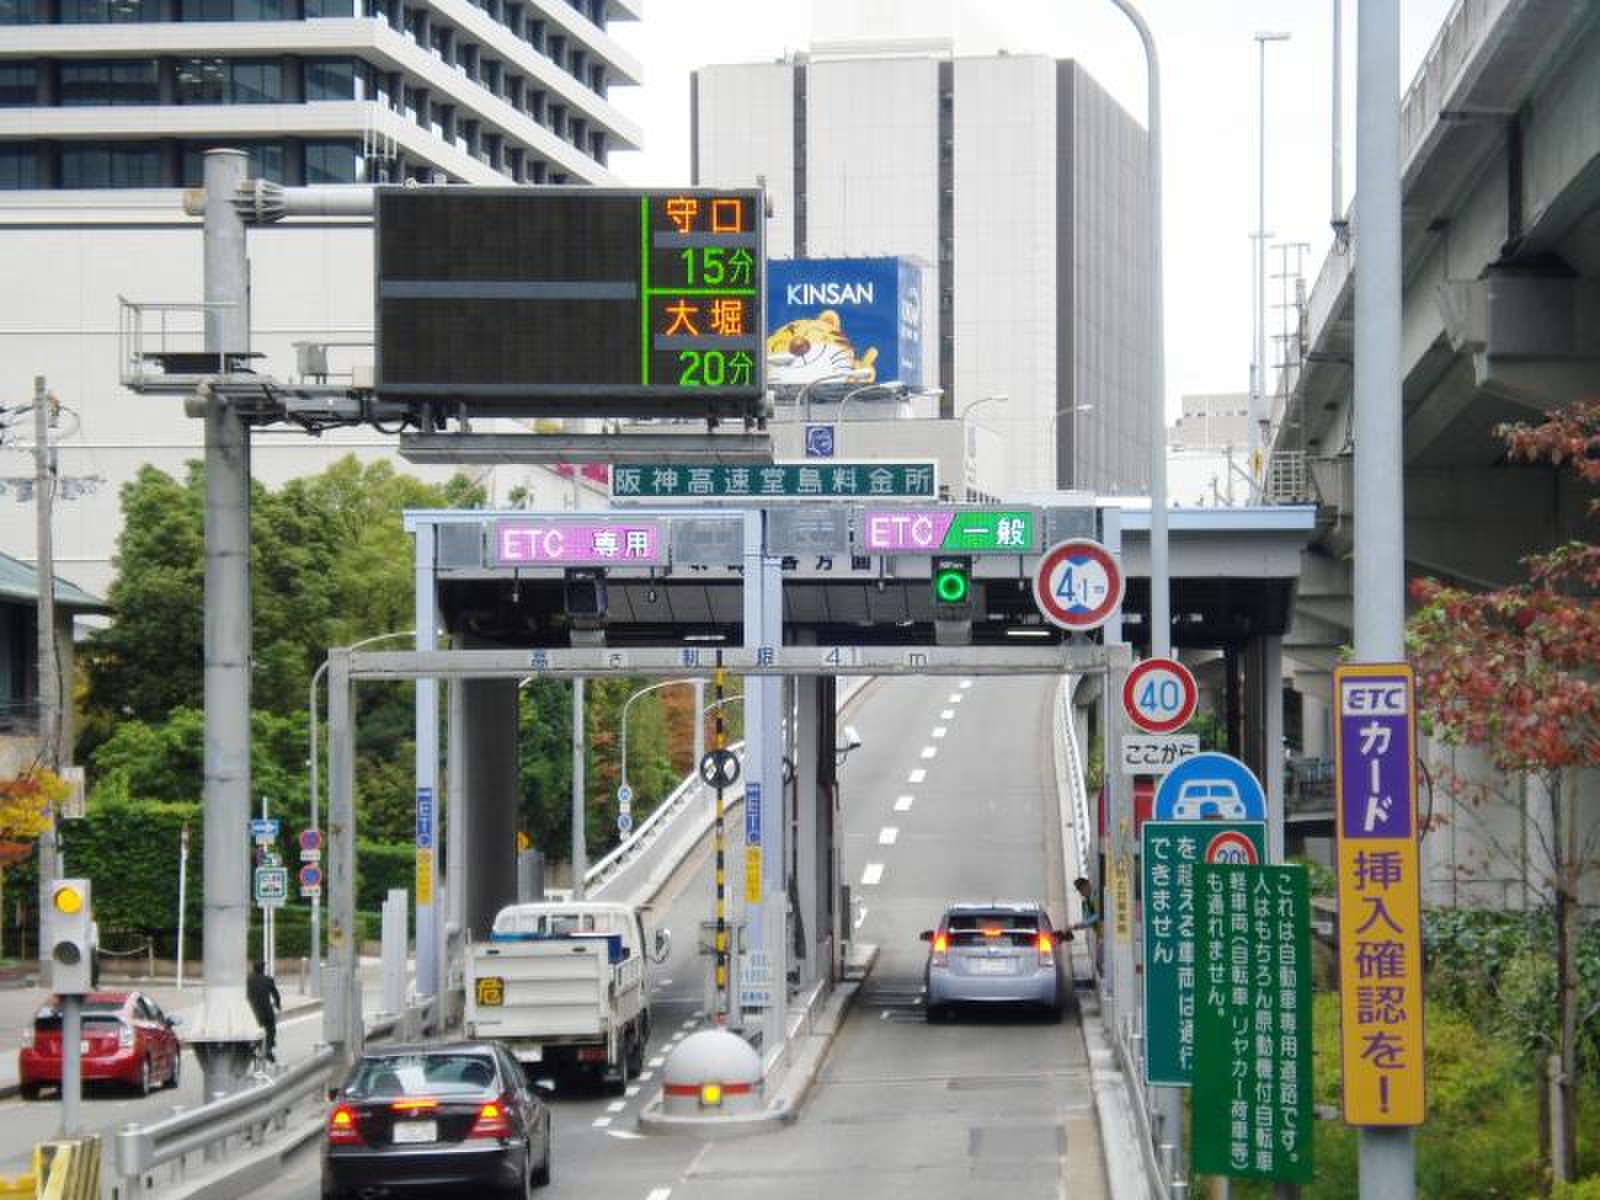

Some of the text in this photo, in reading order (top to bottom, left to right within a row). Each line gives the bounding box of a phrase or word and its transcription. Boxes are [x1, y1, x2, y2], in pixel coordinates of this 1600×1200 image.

[666, 196, 742, 234] 守口
[680, 248, 753, 285] 15分
[786, 283, 874, 305] KINSAN
[665, 300, 742, 337] 大堀
[679, 351, 753, 386] 20分
[614, 467, 932, 495] 阪神高速堂島料金所
[503, 530, 649, 559] ETC 専用
[870, 517, 1025, 546] ETC 一般
[1140, 680, 1179, 712] 40
[1348, 688, 1403, 709] ETC
[1360, 721, 1393, 832] カード
[1151, 837, 1173, 964] できません
